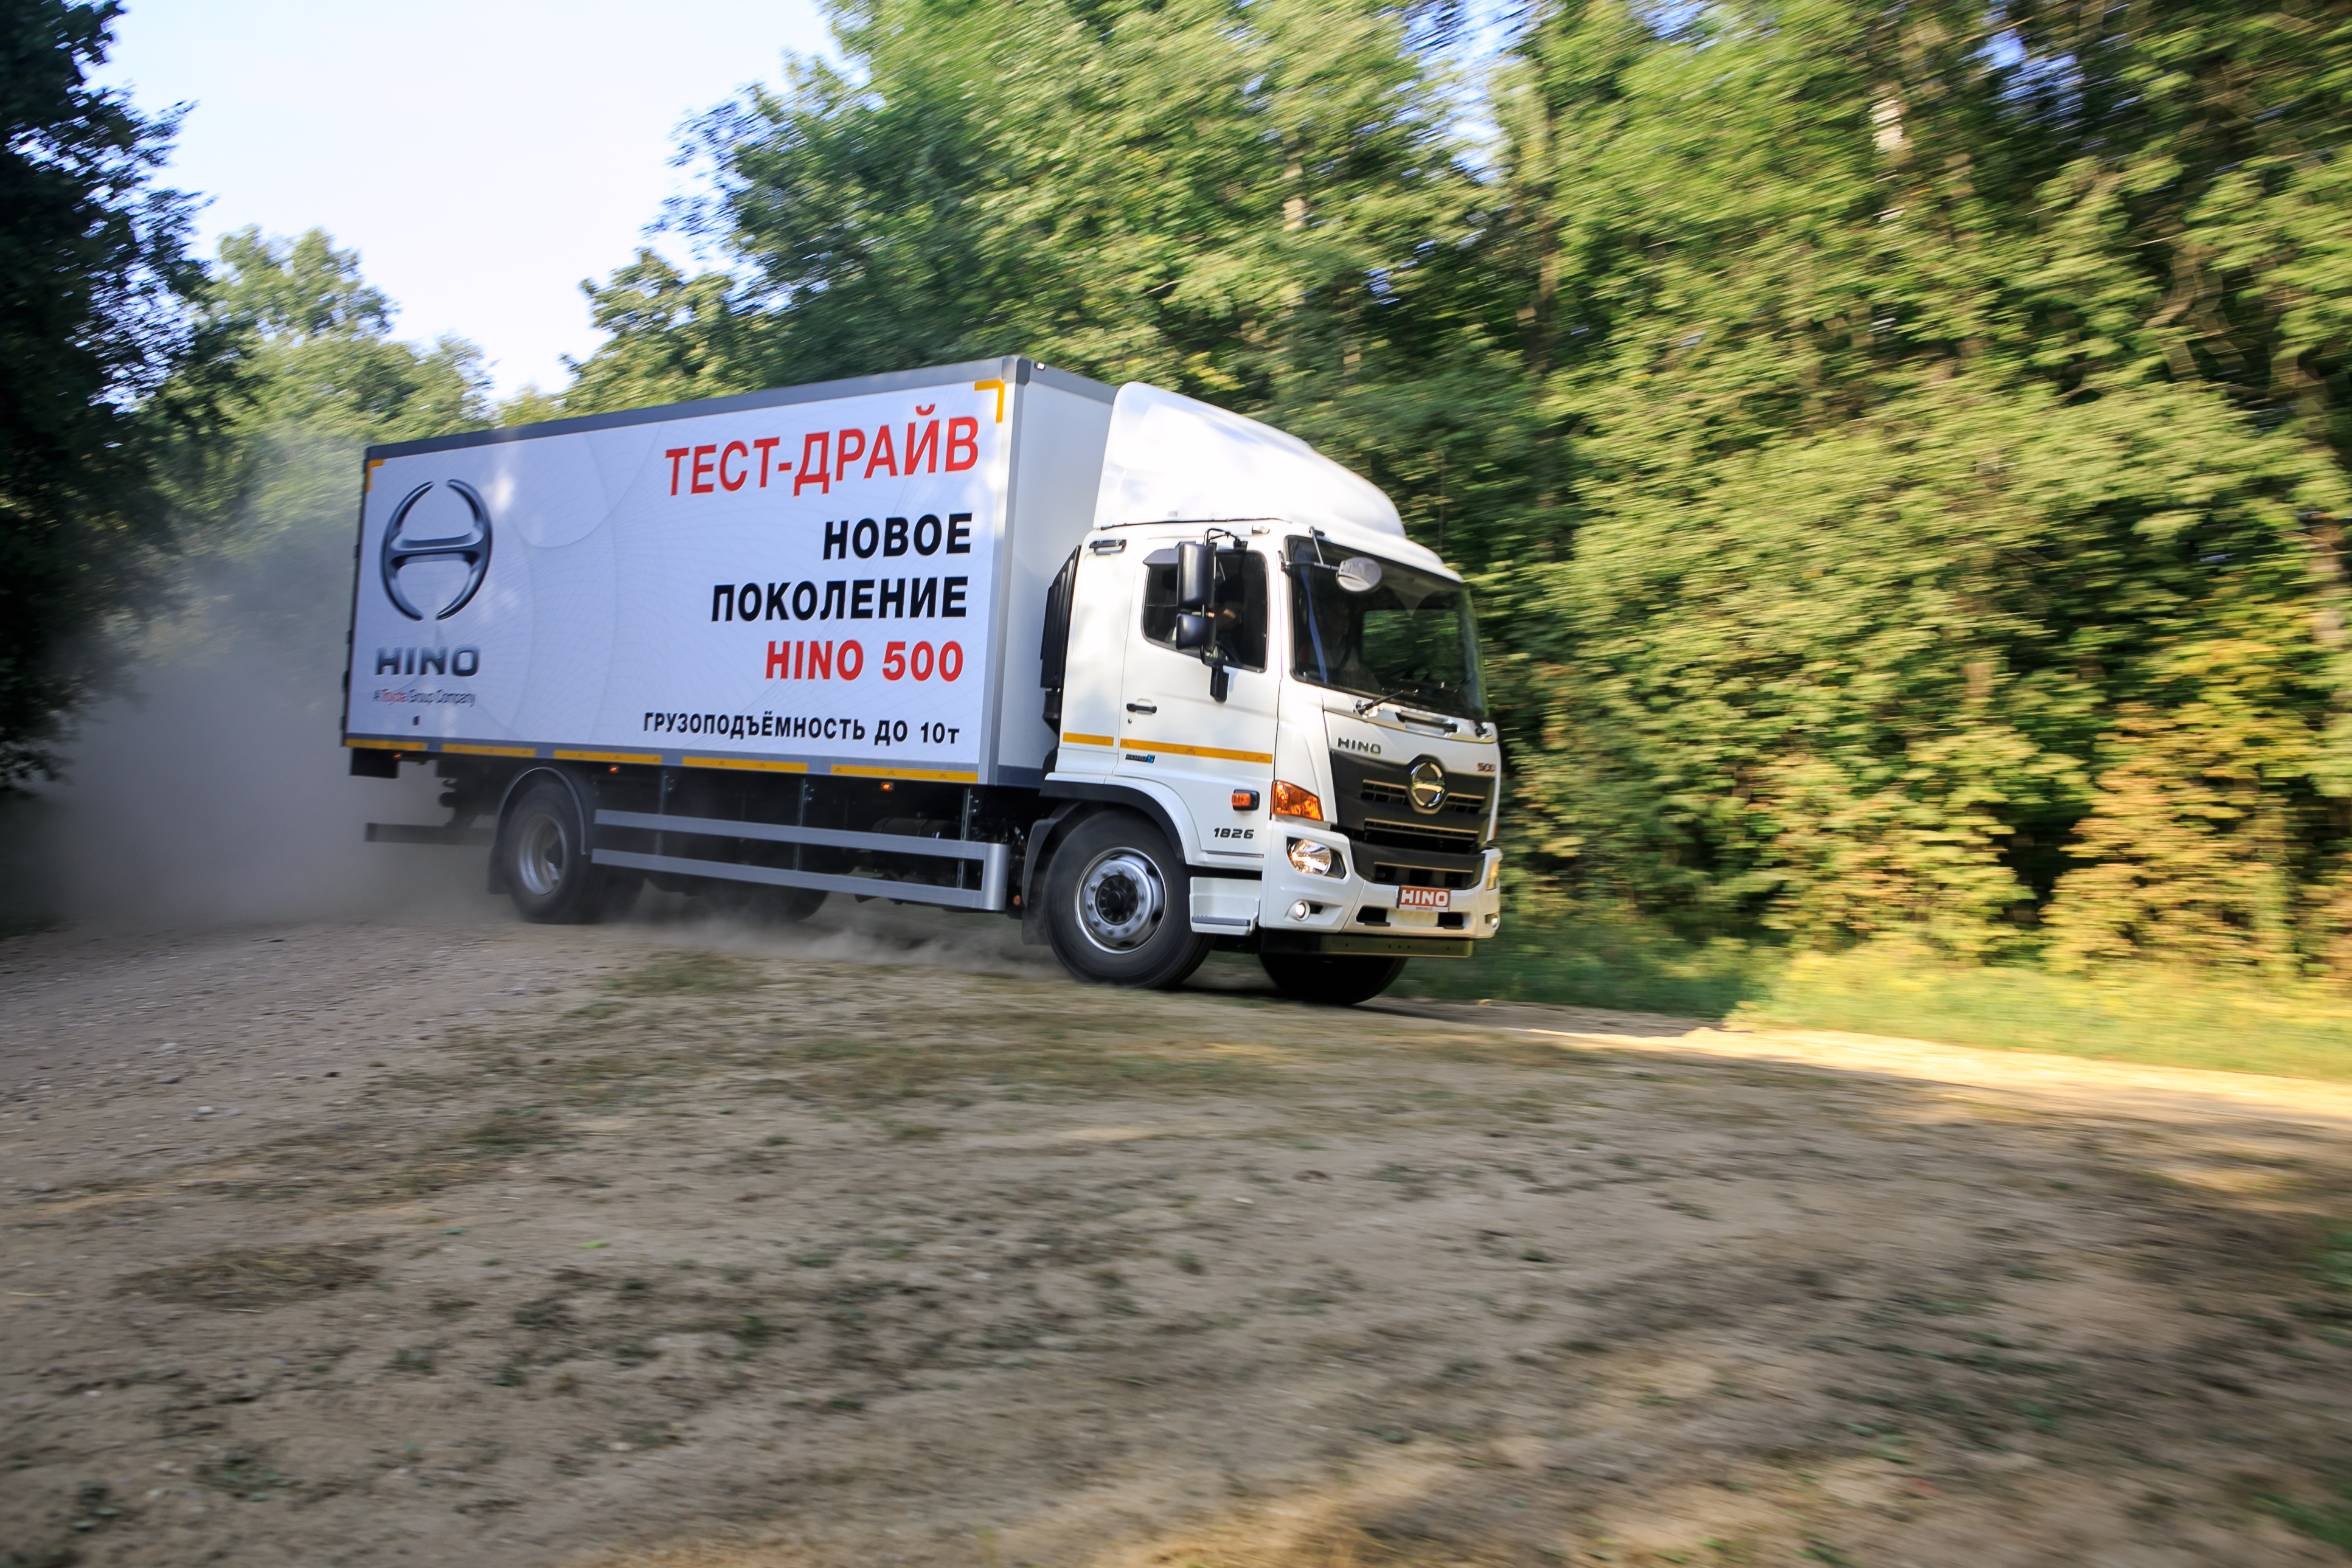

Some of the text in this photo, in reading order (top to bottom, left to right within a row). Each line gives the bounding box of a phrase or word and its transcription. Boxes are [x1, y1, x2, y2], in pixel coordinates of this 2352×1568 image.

[665, 404, 979, 497] ТЕСТ-ДРАЙВ
[822, 513, 973, 561] НОВОЕ
[711, 576, 968, 622] ПОКОЛЕНИЕ
[375, 645, 480, 677] HINO
[766, 640, 963, 682] HINO 500
[644, 711, 866, 740] ГРУЗОПОДЪЁМНОСТЬ
[873, 720, 908, 746] ДО
[1337, 737, 1381, 755] HINO
[1214, 827, 1255, 839] 1826
[1401, 889, 1448, 906] HINO
